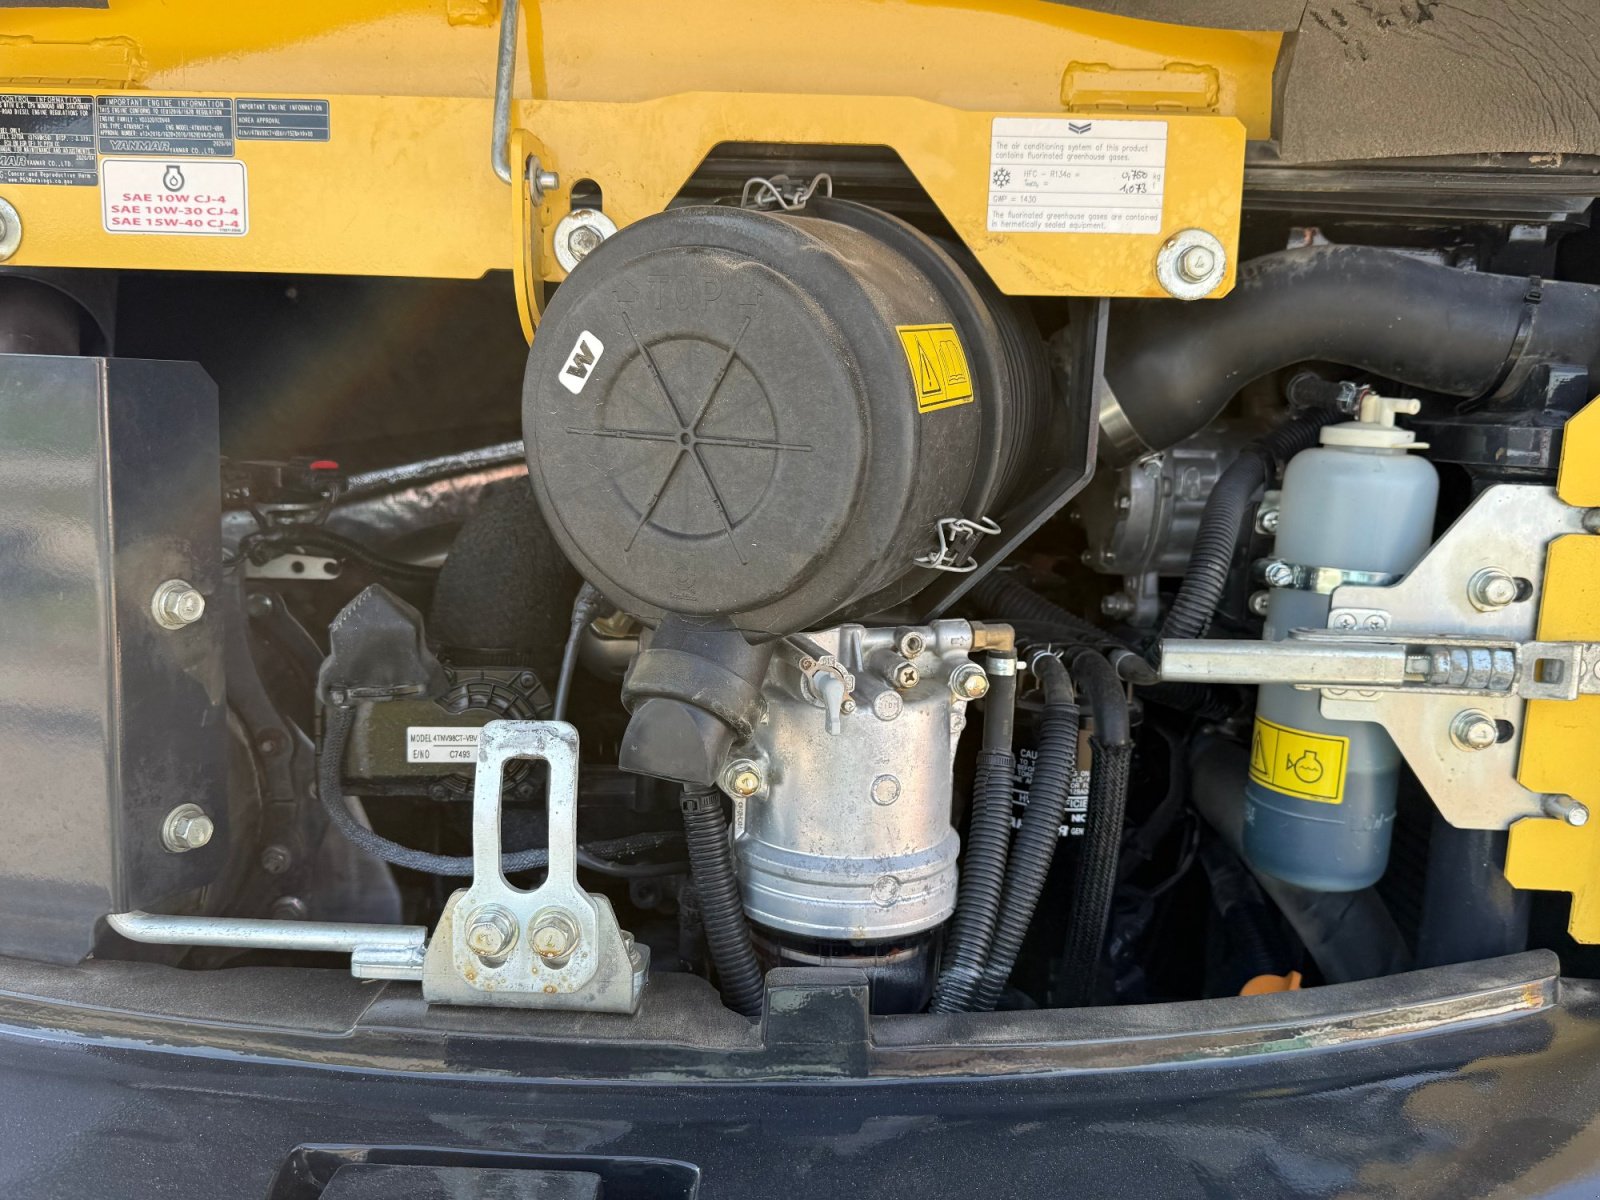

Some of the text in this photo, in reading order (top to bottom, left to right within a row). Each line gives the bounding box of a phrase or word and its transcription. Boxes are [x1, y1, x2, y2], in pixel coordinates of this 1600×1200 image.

[105, 98, 224, 108] IMPORTANT ENGINE INFORMATION
[289, 104, 323, 112] INFORMATION
[109, 139, 170, 152] YANMAR
[996, 141, 1148, 154] The air conditioning system of this product
[995, 151, 1130, 163] contains fluorinated greenhouse gases.
[1023, 170, 1037, 178] HFC
[1050, 170, 1071, 179] R134a
[122, 193, 226, 204] SAE 10W CJ-4
[993, 195, 1008, 203] GWP
[111, 205, 239, 216] SAE 10W-30 CJ-4
[992, 210, 1158, 222] The fluorinated greenhouse gases are contained
[112, 217, 239, 228] SAE 15W-40 CJ-4
[1000, 220, 1042, 229] hermetically
[1044, 220, 1067, 228] sealed
[1069, 221, 1106, 230] equipment.
[648, 274, 723, 311] TOP
[410, 734, 432, 743] MODEL
[449, 750, 471, 759] C7493
[1020, 748, 1038, 760] CAU
